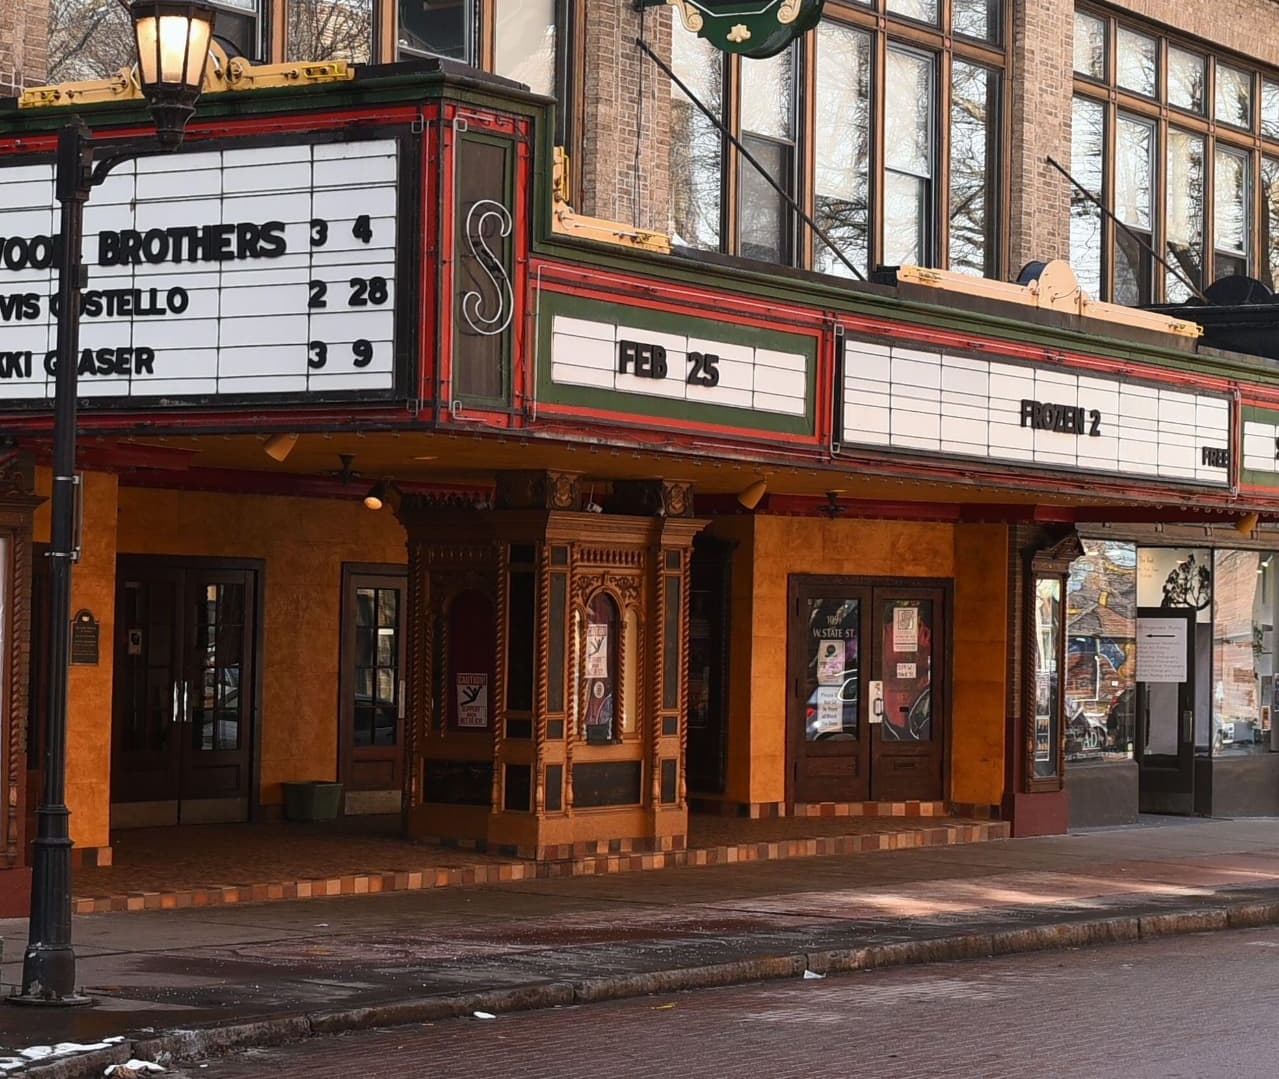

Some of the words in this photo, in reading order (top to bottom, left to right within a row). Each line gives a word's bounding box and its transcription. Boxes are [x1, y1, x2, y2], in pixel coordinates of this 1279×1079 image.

[98, 221, 287, 267] BROTHERS
[309, 218, 328, 247] 3
[352, 215, 373, 244] 4
[308, 279, 327, 308] 2
[348, 276, 389, 307] 28
[43, 346, 155, 377] GASER
[308, 340, 327, 369] 3
[352, 339, 373, 368] 9
[619, 339, 668, 380] FEB
[686, 351, 720, 388] 25
[1020, 398, 1085, 436] FROZEN
[1088, 409, 1101, 437] 2
[1202, 446, 1230, 469] FREE
[822, 628, 843, 638] STATE
